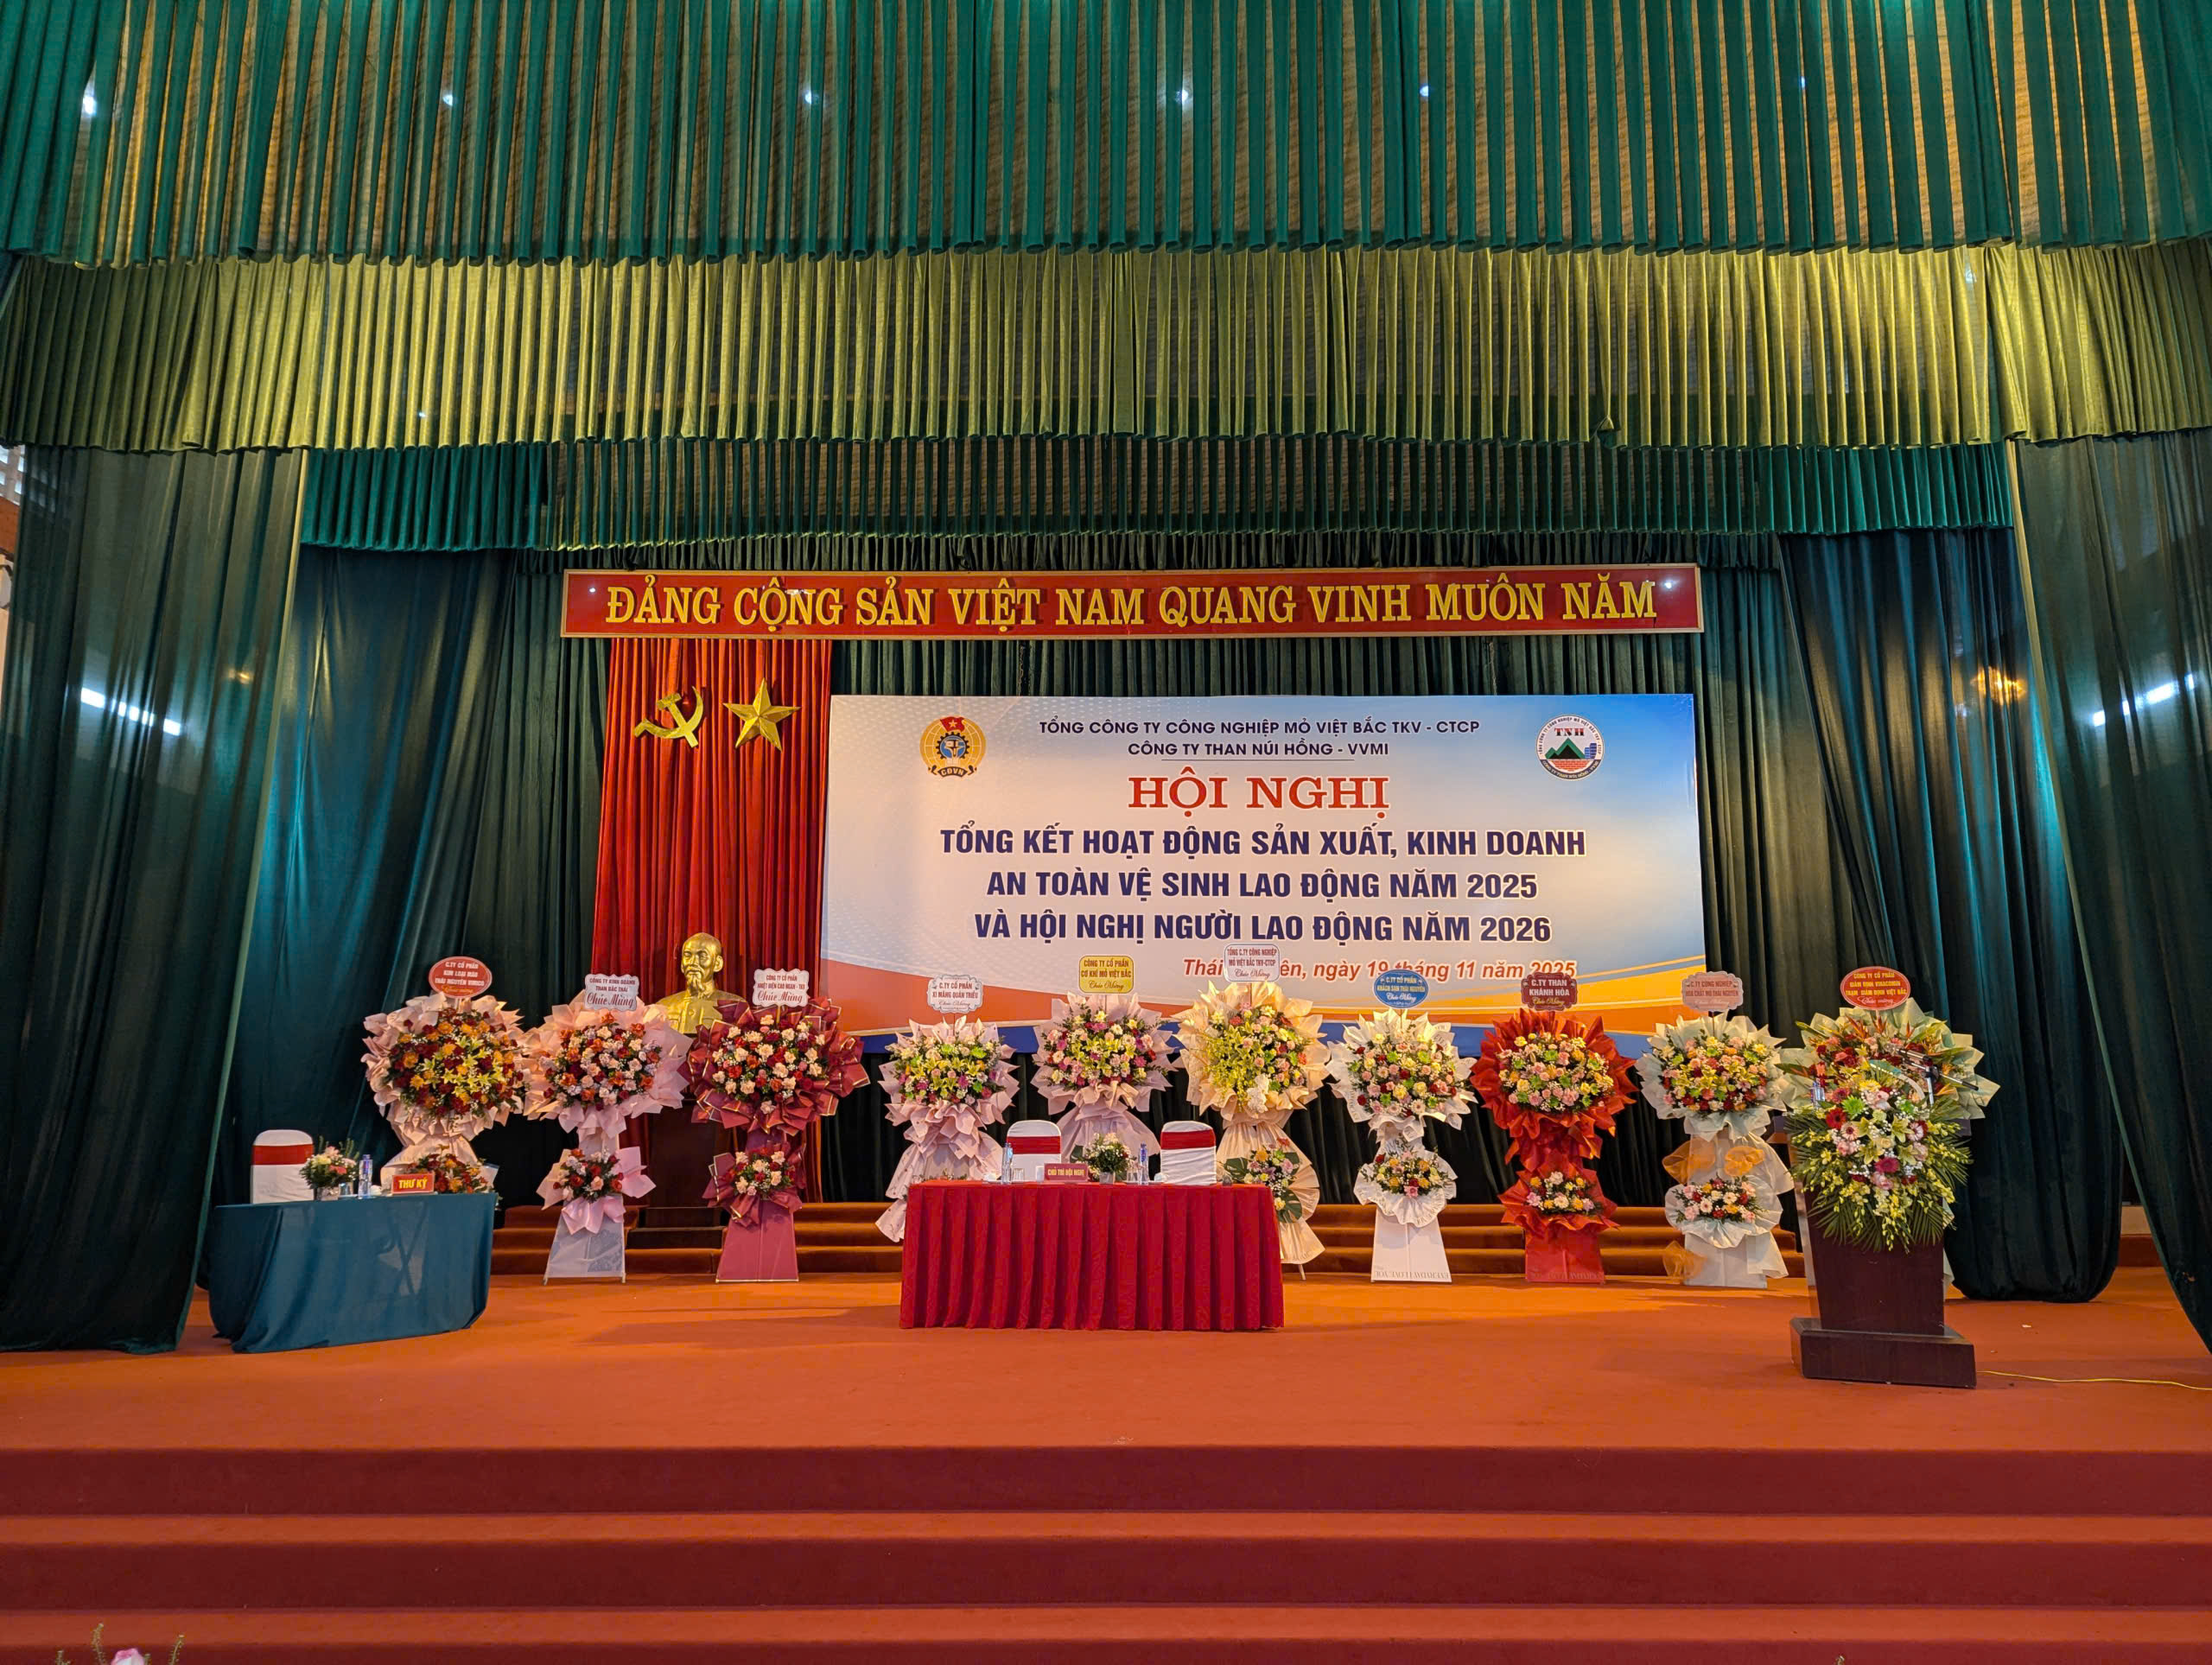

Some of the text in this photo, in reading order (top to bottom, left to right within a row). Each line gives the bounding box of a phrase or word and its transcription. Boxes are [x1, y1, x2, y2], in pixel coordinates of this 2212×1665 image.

[605, 573, 1656, 632] ĐẢNG CỘNG SẢN VIỆT NAM QUANG VINH MUÔN NĂM
[1039, 715, 1084, 734] TỔNG
[1089, 719, 1139, 734] CÔNG
[1143, 722, 1160, 734] TY
[1166, 719, 1215, 734] CÔNG
[1221, 719, 1280, 736] NGHIỆP
[1284, 718, 1311, 734] MỎ
[1316, 719, 1348, 736] VIỆT
[1353, 716, 1387, 734] BẮC
[1391, 721, 1421, 733] TKV
[1436, 721, 1479, 733] CTCP
[1554, 728, 1585, 736] TNH
[1128, 740, 1178, 755] CÔNG
[1183, 743, 1199, 755] TY
[1205, 744, 1246, 755] THAN
[1252, 740, 1279, 755] NÚI
[1285, 738, 1333, 755] HỒNG
[1347, 743, 1389, 755] VVMI
[1128, 766, 1389, 819] HỘI NGHỊ
[940, 820, 1586, 860] TỔNG KẾT HOẠT ĐỘNG SẢN XUẤT, KINH DOANH
[987, 867, 1537, 903] AN TOÀN VỆ SINH LAO ĐỘNG NĂM 2025
[975, 909, 1550, 946] VÀ HỘI NGHỊ NGƯỜI LAO ĐỘNG NĂM 2026
[1084, 958, 1097, 967] CÔNG
[1184, 959, 1224, 975] Thái
[1313, 961, 1360, 981] ngày
[1367, 961, 1389, 977] 19
[1456, 962, 1476, 977] 11
[1483, 962, 1522, 978] năm
[1530, 962, 1576, 977] 2025
[587, 992, 607, 1005] Chúc
[758, 990, 778, 1001] Chúc
[399, 1176, 428, 1189] THƯ KÝ
